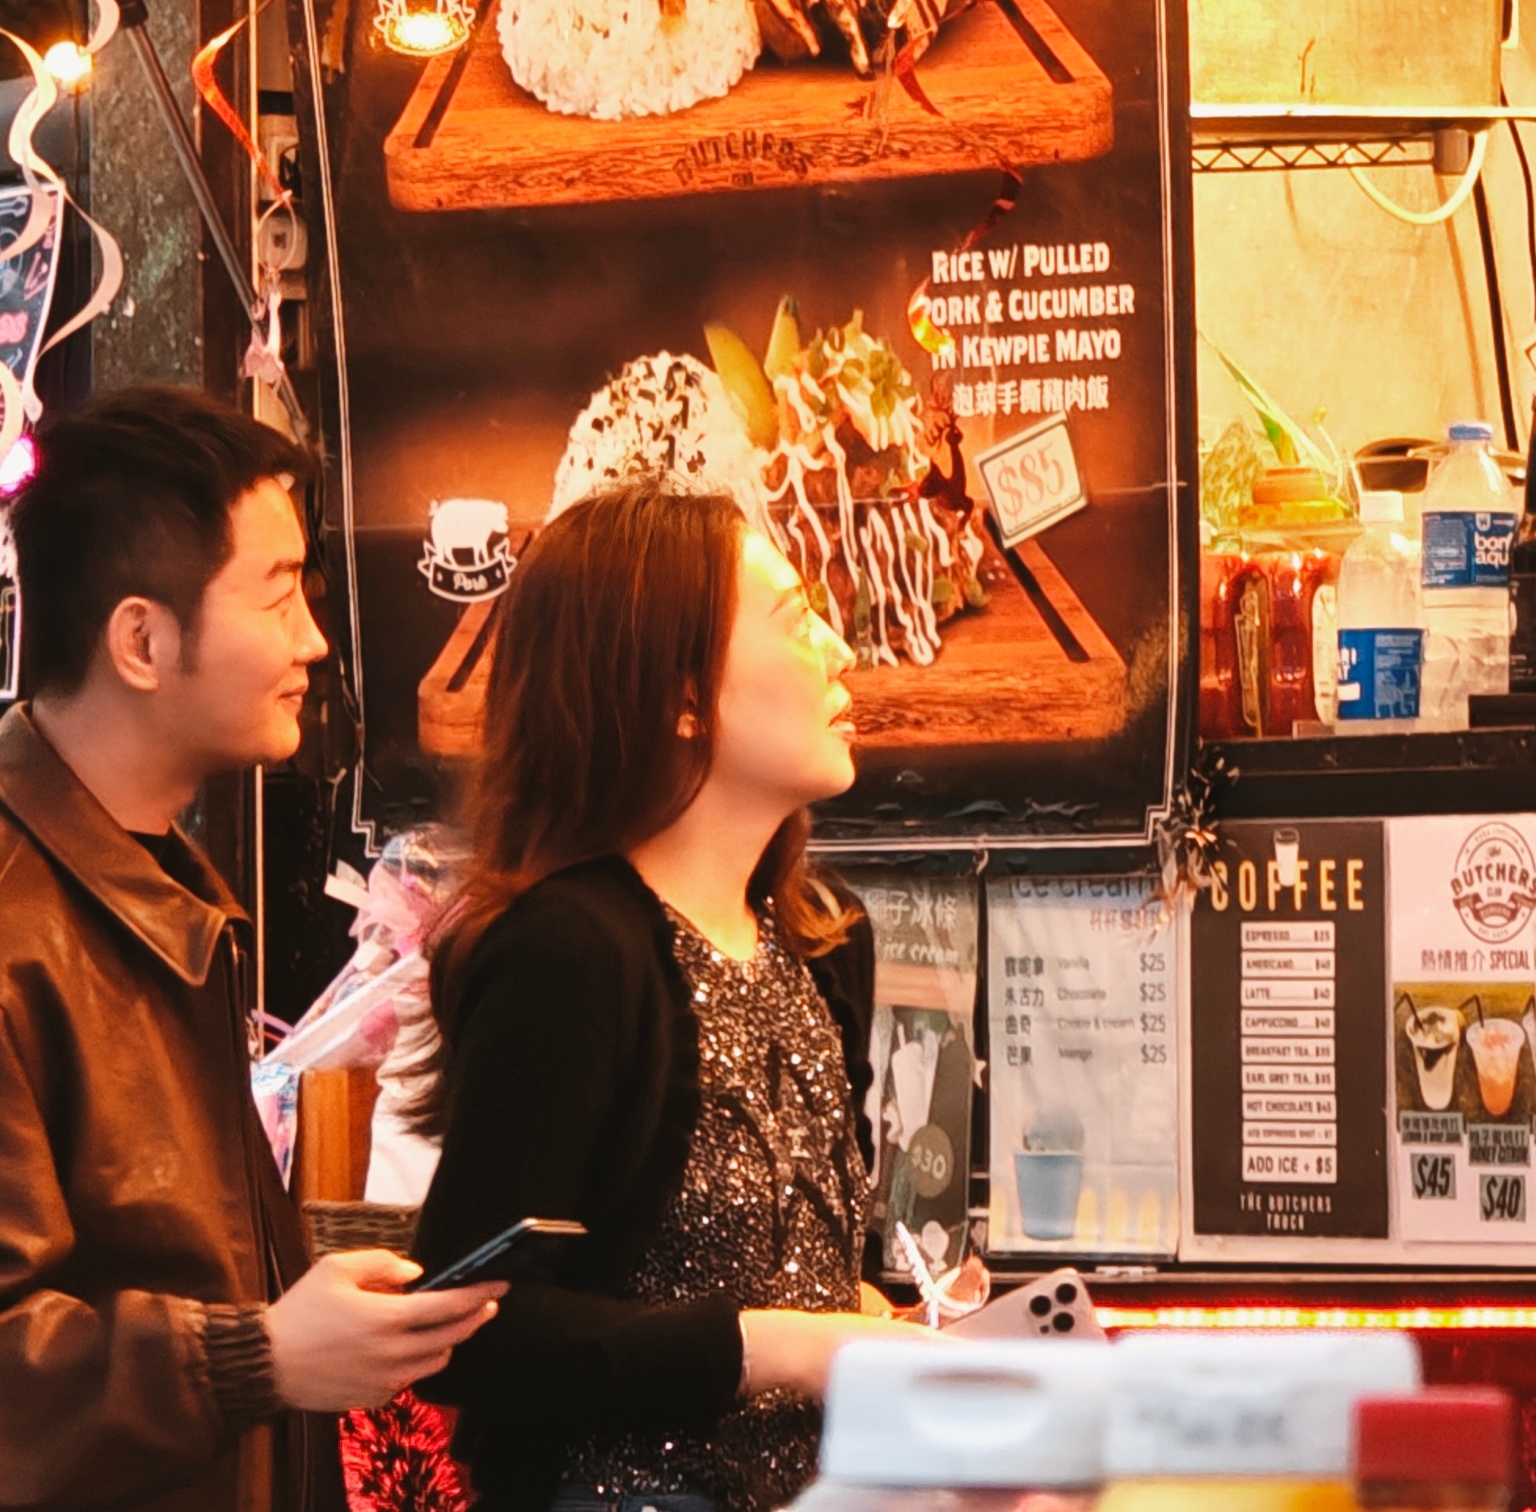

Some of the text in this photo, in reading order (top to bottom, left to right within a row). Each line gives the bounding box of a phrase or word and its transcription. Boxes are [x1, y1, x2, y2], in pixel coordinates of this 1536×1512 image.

[932, 242, 1110, 285] RICE W/ PULLED
[922, 284, 1135, 327] PORK & CUCUMBER
[962, 333, 1050, 368] KEWPIE
[1055, 329, 1122, 362] MAYO
[997, 443, 1065, 519] $85
[1475, 550, 1510, 570] aqu
[1212, 859, 1364, 912] COFFEE
[1139, 953, 1166, 973] $25
[1490, 949, 1530, 971] SPECIAL
[1139, 983, 1167, 1002] $25
[1245, 989, 1271, 1000] LATTE
[1140, 1013, 1167, 1033] $25
[1141, 1043, 1167, 1064] $25
[1247, 1156, 1274, 1173] ADD
[1278, 1157, 1298, 1173] ICE
[1316, 1157, 1332, 1174] $5
[1415, 1155, 1451, 1199] $45
[1269, 1194, 1332, 1213] BUTCHERS
[1484, 1176, 1521, 1221] $40
